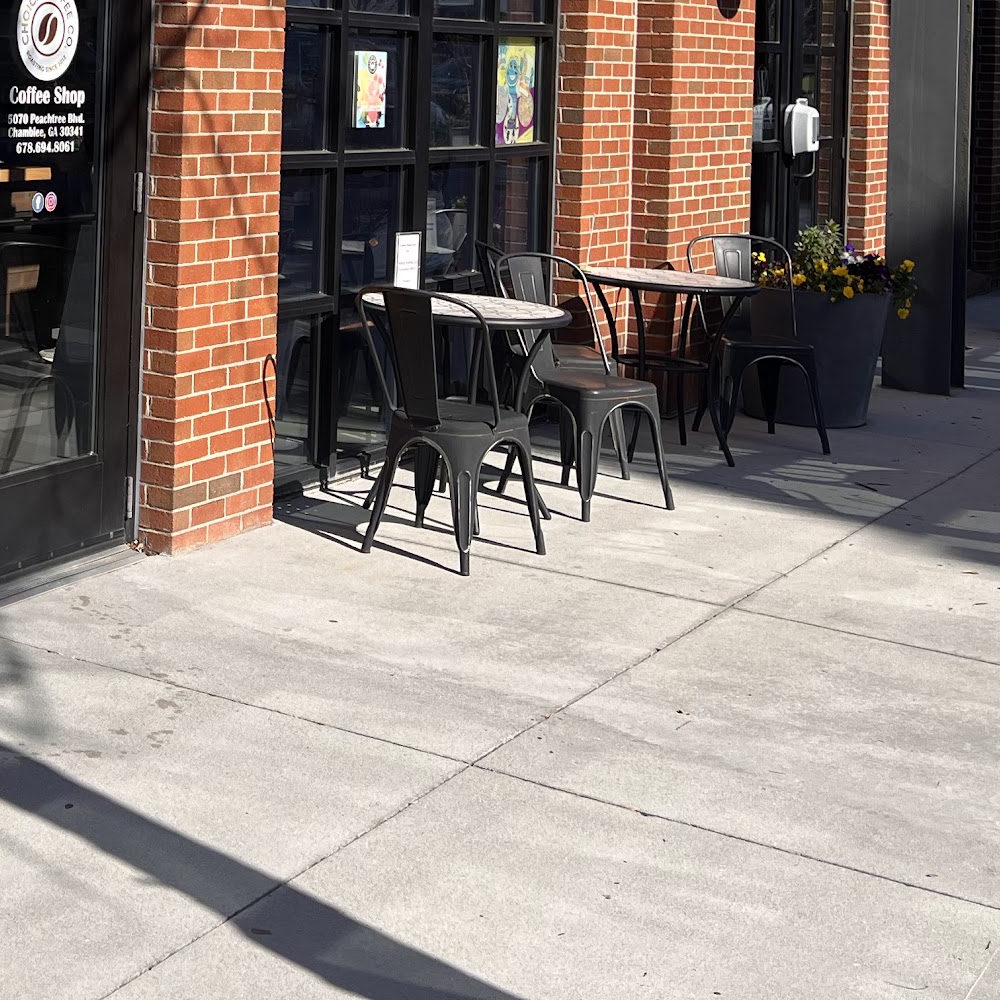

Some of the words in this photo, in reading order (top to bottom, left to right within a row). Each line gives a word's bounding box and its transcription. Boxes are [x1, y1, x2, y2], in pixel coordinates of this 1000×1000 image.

[9, 86, 51, 104] Coffee
[53, 86, 85, 108] Shop
[8, 113, 29, 125] 5070
[30, 113, 66, 124] Peachtree
[67, 113, 85, 124] Blvd.
[8, 126, 46, 138] Chamblee,
[47, 126, 58, 137] GA
[59, 126, 83, 137] 30341
[16, 140, 75, 154] 678.694.8061
